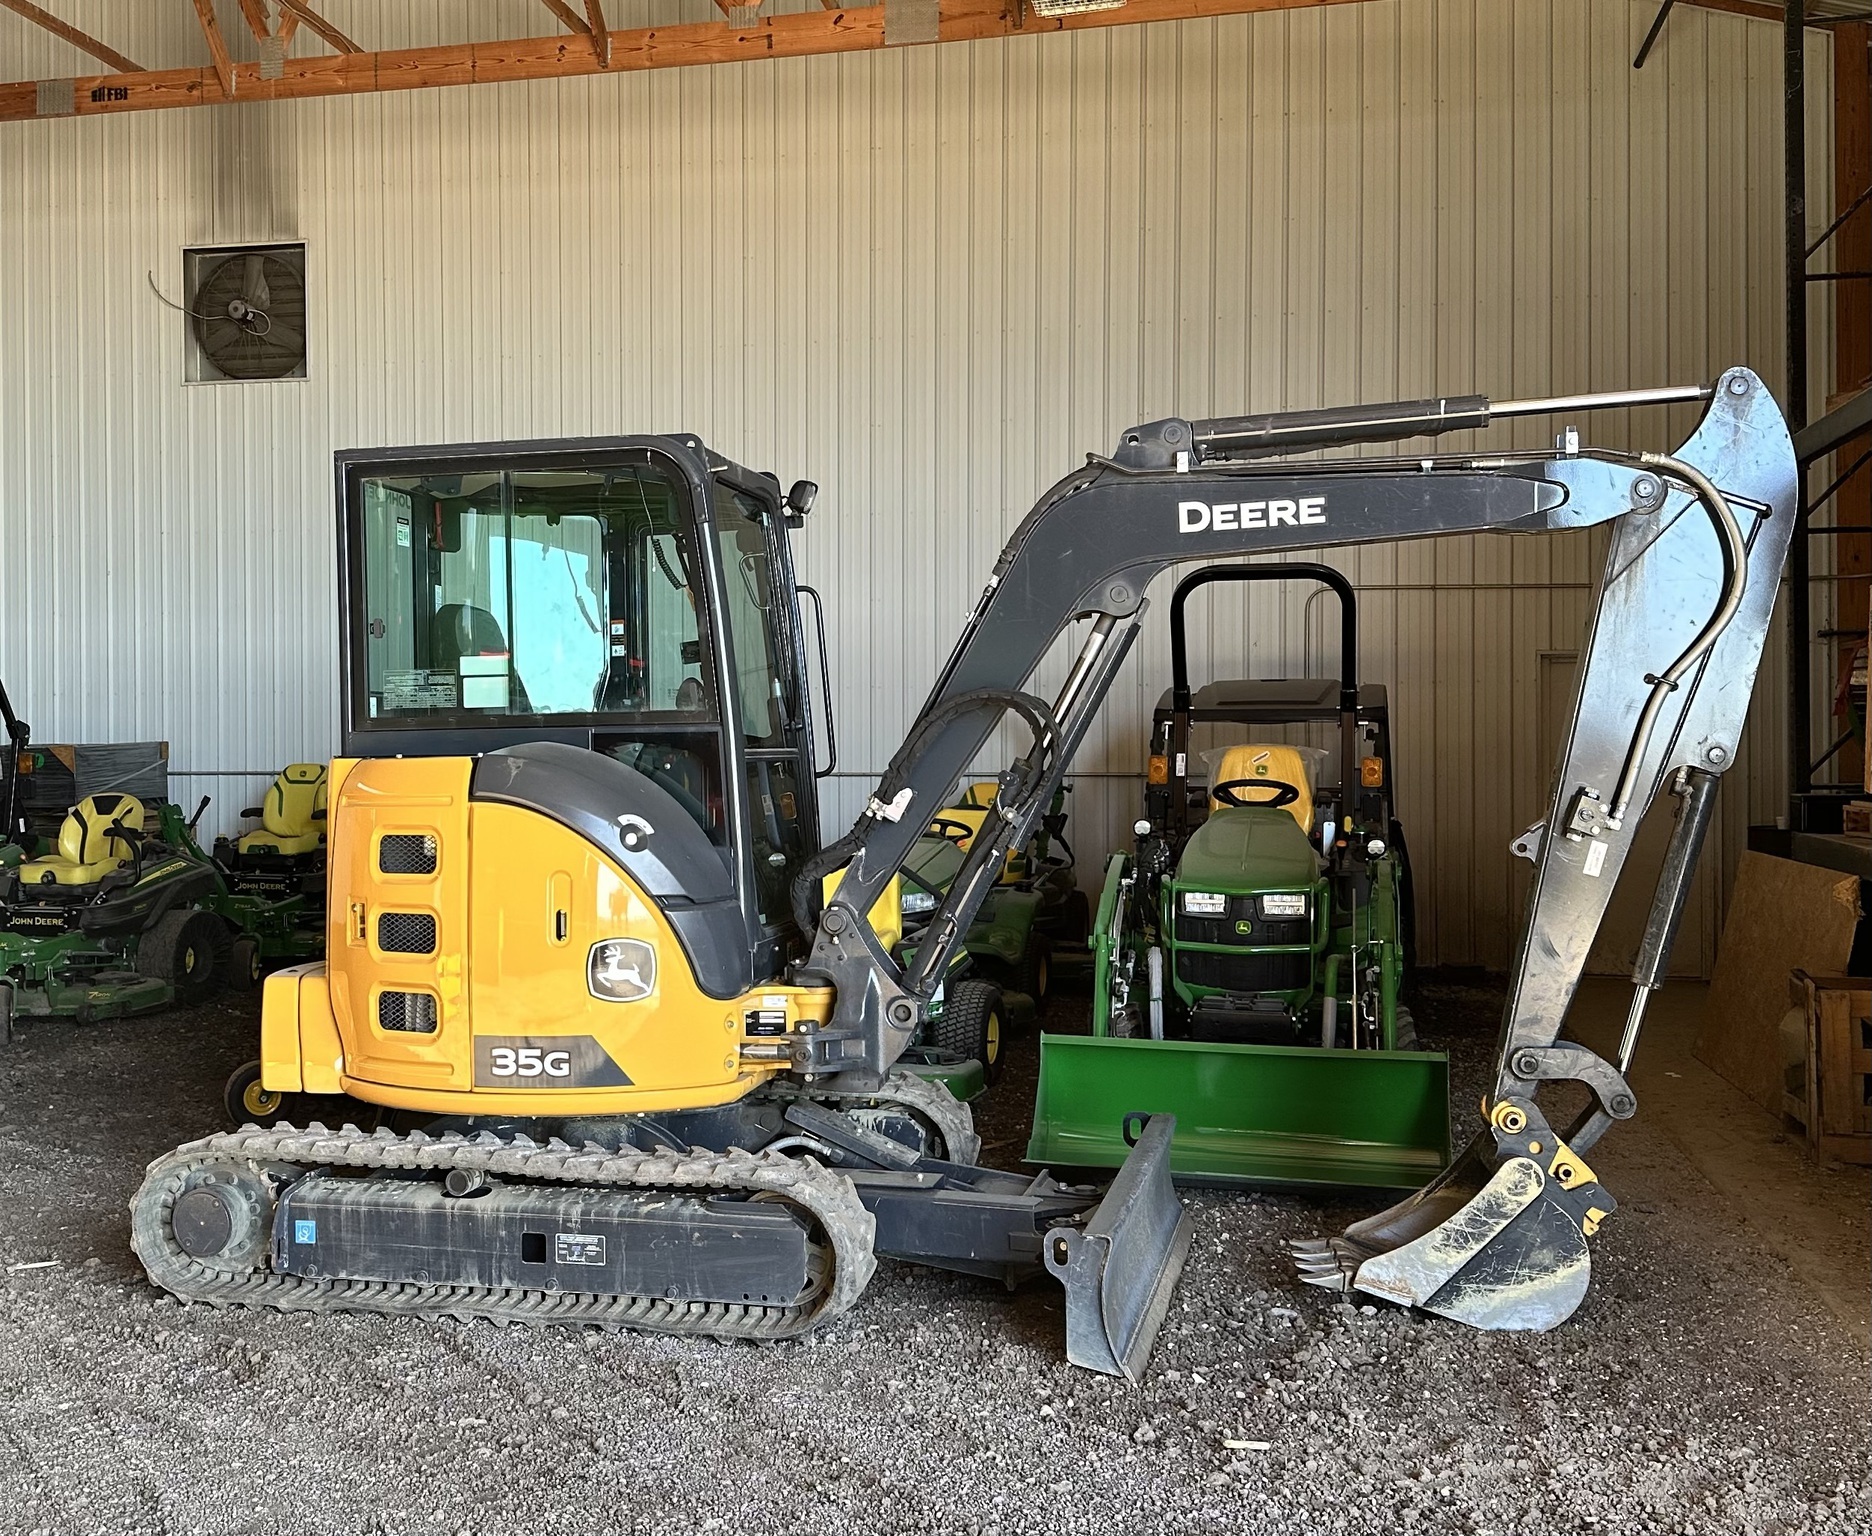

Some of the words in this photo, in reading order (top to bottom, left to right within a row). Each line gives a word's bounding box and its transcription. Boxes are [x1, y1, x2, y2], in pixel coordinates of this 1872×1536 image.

[1178, 497, 1326, 534] DEERE
[238, 882, 258, 890] JOHN
[10, 916, 33, 925] JOHN
[34, 916, 64, 926] DEERE
[491, 1047, 570, 1077] 35G
